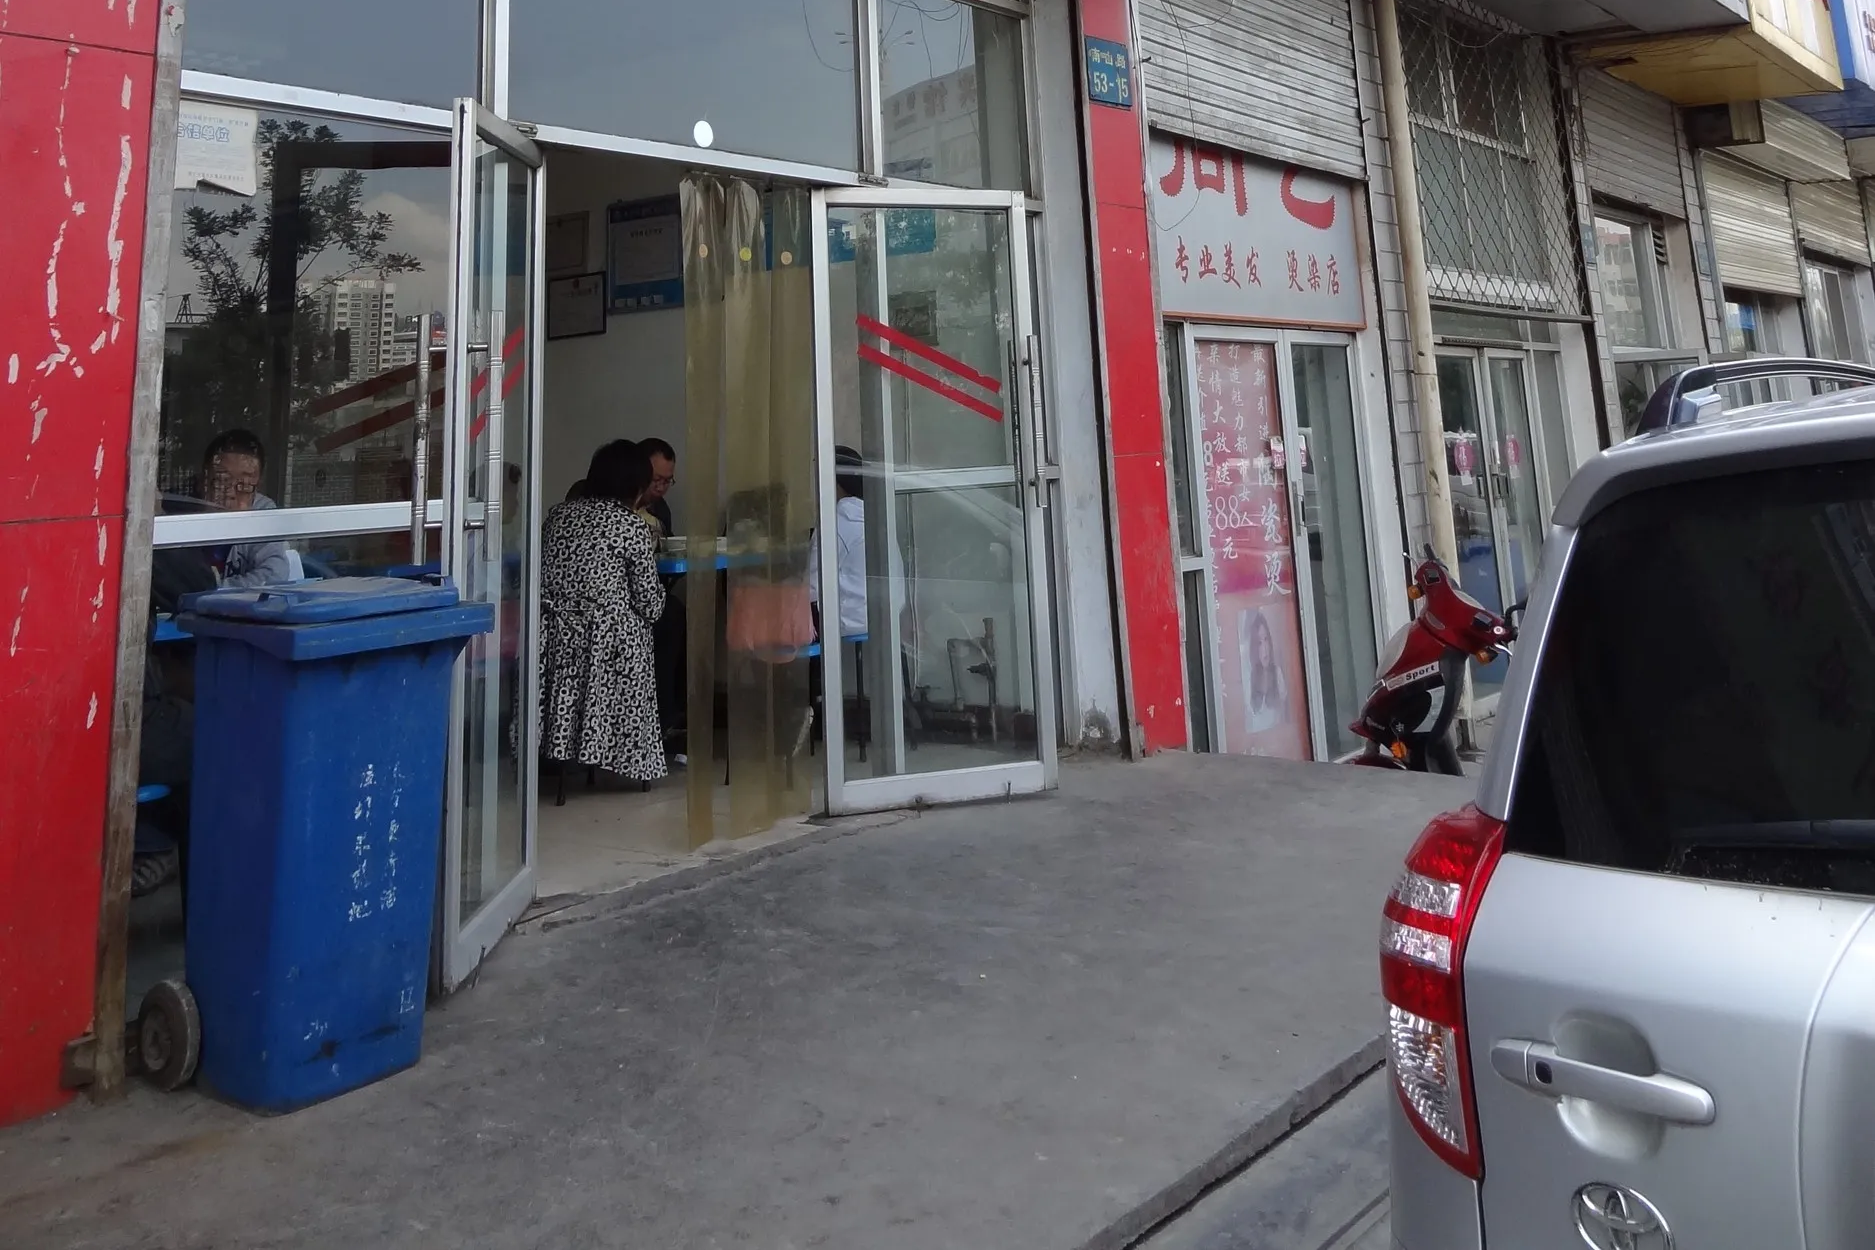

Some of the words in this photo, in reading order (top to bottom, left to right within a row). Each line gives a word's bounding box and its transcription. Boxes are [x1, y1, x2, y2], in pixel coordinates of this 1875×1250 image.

[1089, 47, 1126, 69] 南山路
[1093, 71, 1129, 100] 53-15
[1174, 235, 1262, 288] 专业美发
[1286, 249, 1341, 296] 烫染店
[1405, 664, 1436, 681] Sport
